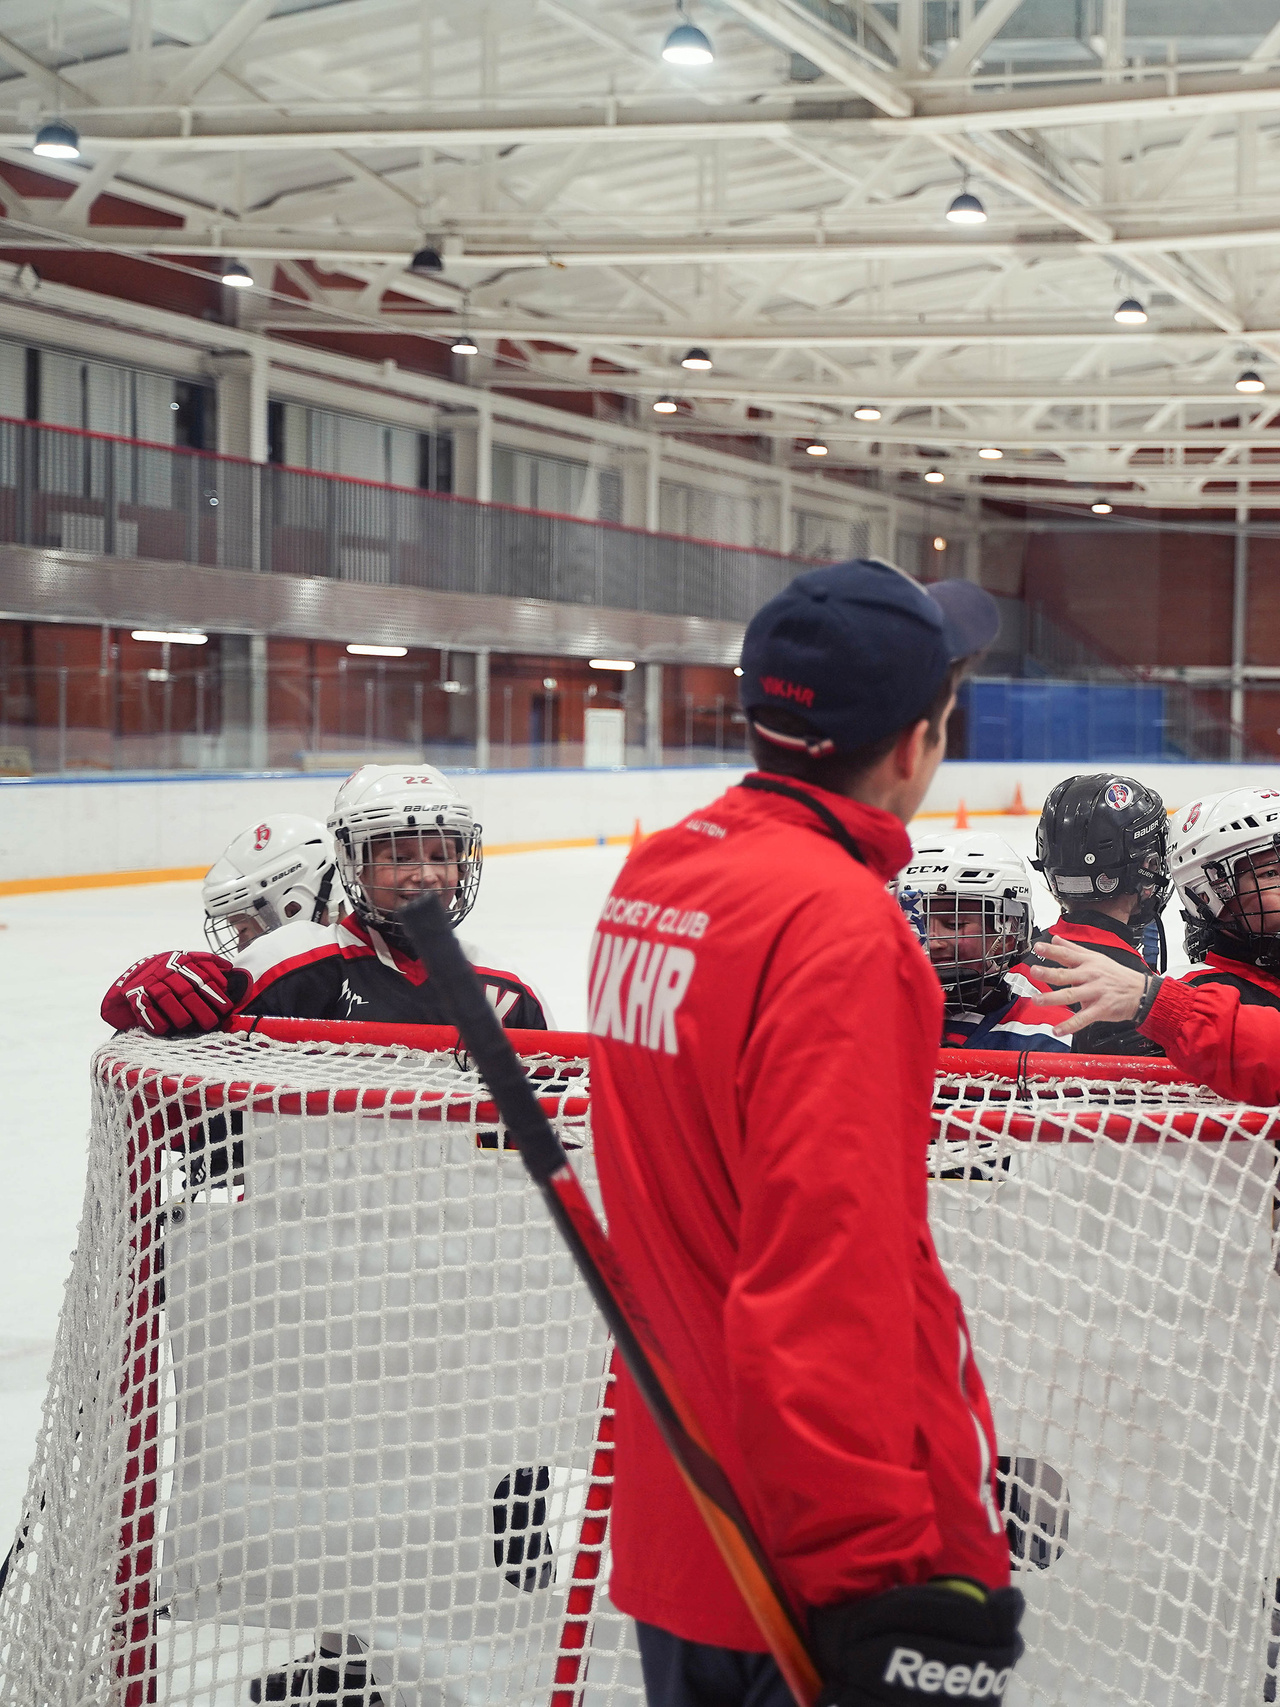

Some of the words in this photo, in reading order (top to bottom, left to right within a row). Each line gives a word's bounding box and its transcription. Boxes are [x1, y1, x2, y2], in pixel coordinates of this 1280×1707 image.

[403, 776, 432, 785] 22
[403, 804, 448, 812] BAUER
[1133, 820, 1159, 840] BAUER
[271, 862, 302, 883] BAUER
[906, 865, 949, 875] CCM
[1012, 885, 1029, 894] CCM
[601, 896, 661, 928] OCKEY
[656, 907, 710, 940] CLUB
[884, 1646, 1014, 1698] Reebo
